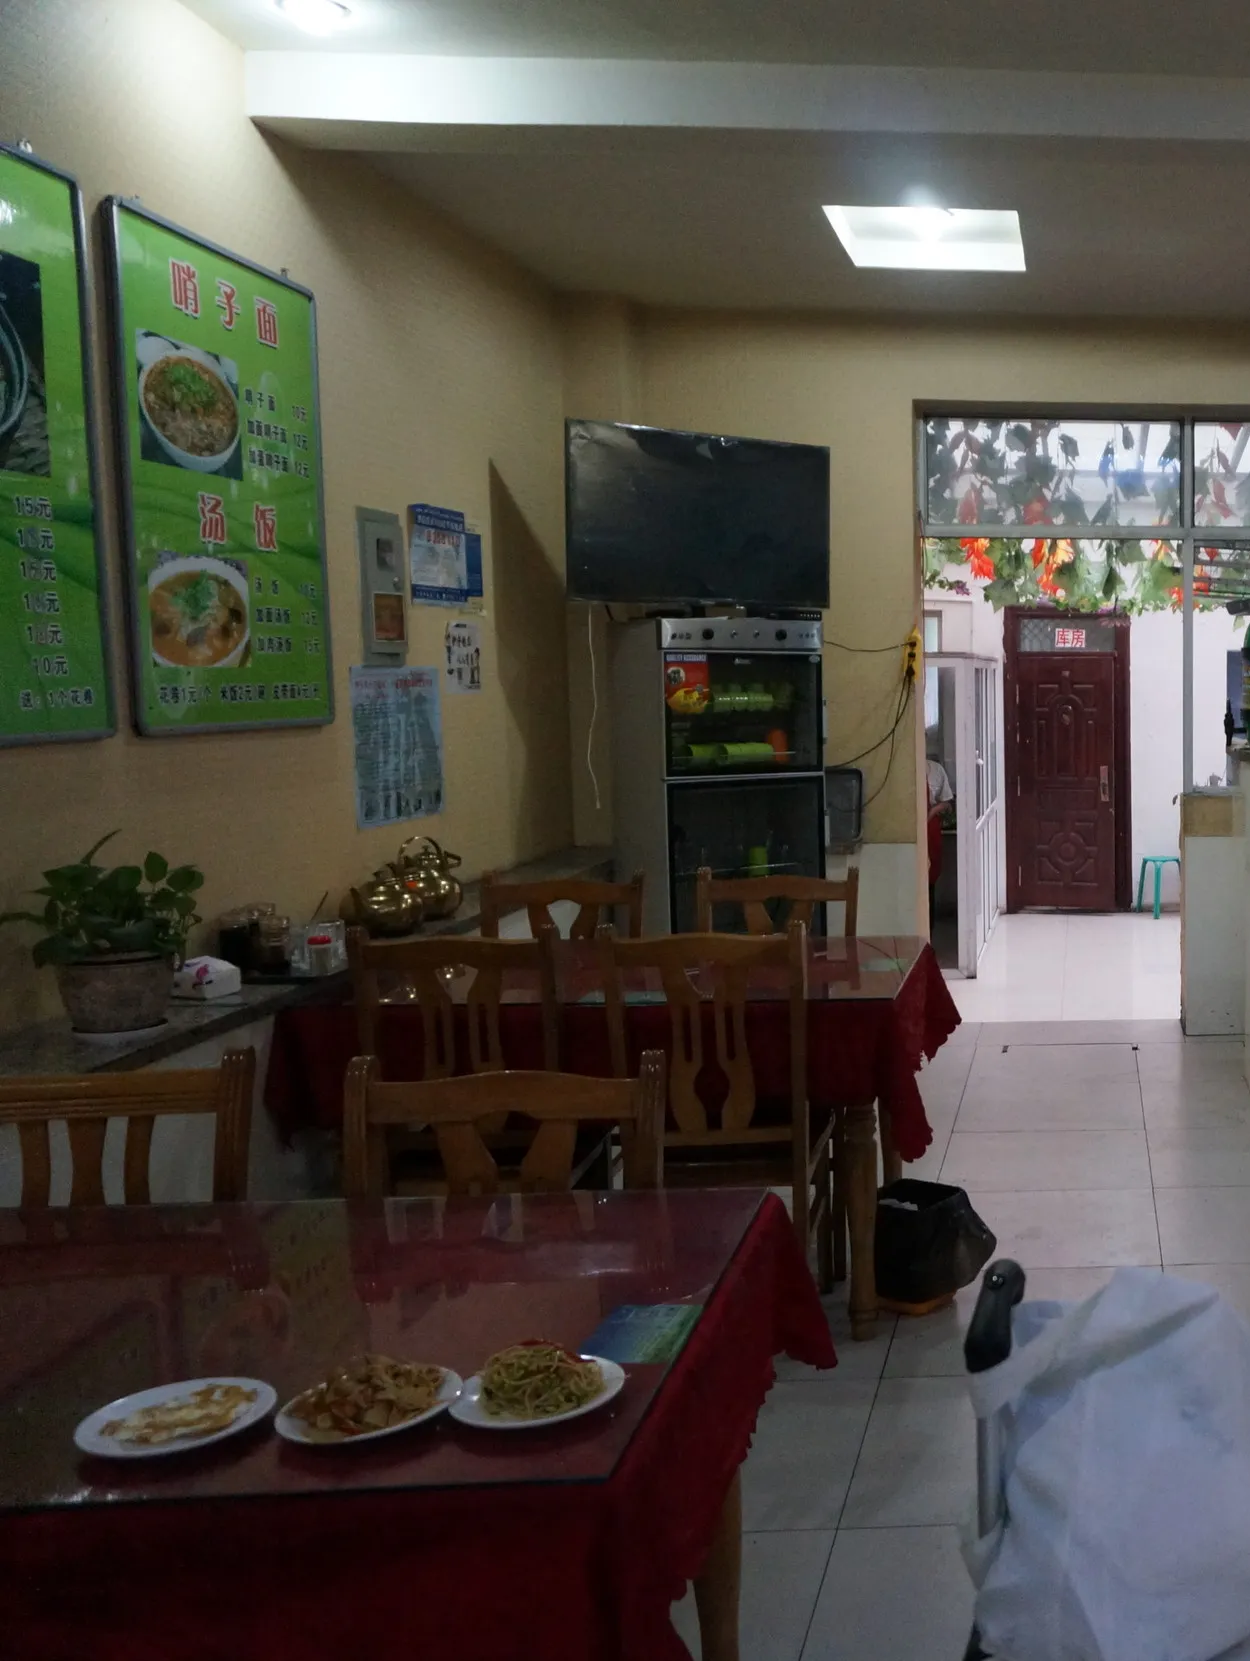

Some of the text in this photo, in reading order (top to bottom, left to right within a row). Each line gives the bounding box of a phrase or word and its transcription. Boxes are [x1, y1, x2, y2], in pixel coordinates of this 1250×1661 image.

[170, 260, 278, 347] 哨子面
[15, 496, 52, 518] 15元
[199, 492, 277, 551] 汤饭
[16, 528, 55, 550] 1元
[24, 592, 61, 613] 1元
[26, 624, 63, 644] 1元
[1055, 629, 1086, 648] 库房
